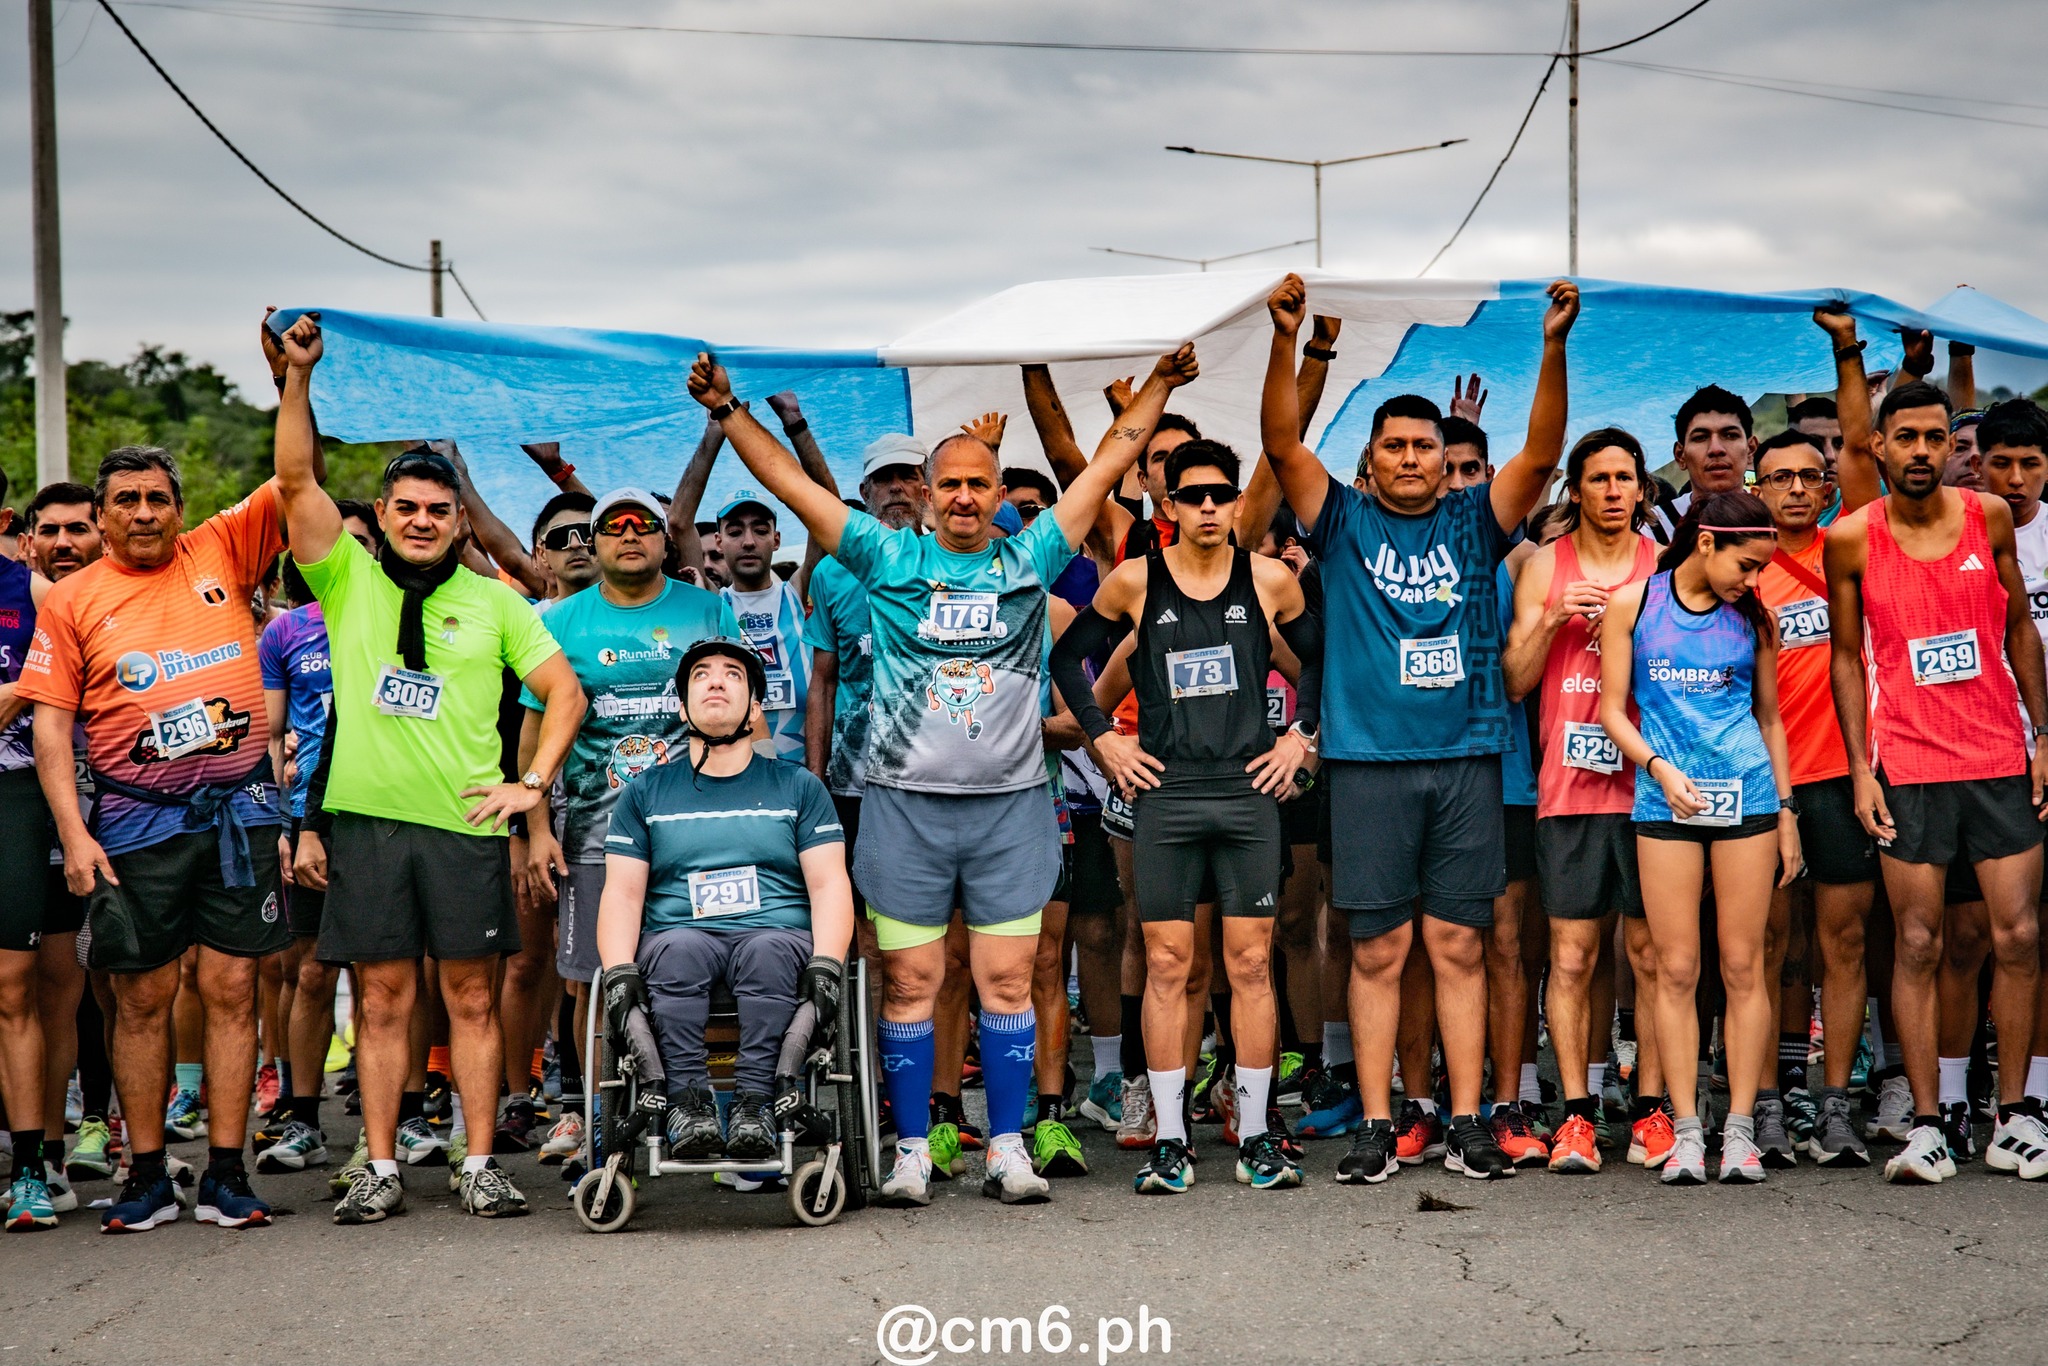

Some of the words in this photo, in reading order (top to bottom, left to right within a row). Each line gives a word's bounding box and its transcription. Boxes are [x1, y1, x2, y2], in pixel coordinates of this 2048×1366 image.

[747, 617, 773, 629] BSE
[940, 605, 989, 628] 176
[1779, 608, 1830, 640] 290
[158, 651, 183, 662] los
[163, 643, 241, 680] primeros
[301, 652, 322, 660] CLUB
[1410, 649, 1456, 675] 368
[1648, 659, 1670, 667] CLUB
[1921, 644, 1974, 675] 269
[1184, 660, 1223, 687] 73
[1649, 668, 1721, 682] SOMBRA
[384, 679, 434, 710] 306
[163, 712, 207, 747] 296
[1571, 735, 1618, 761] 329
[700, 880, 752, 908] 291
